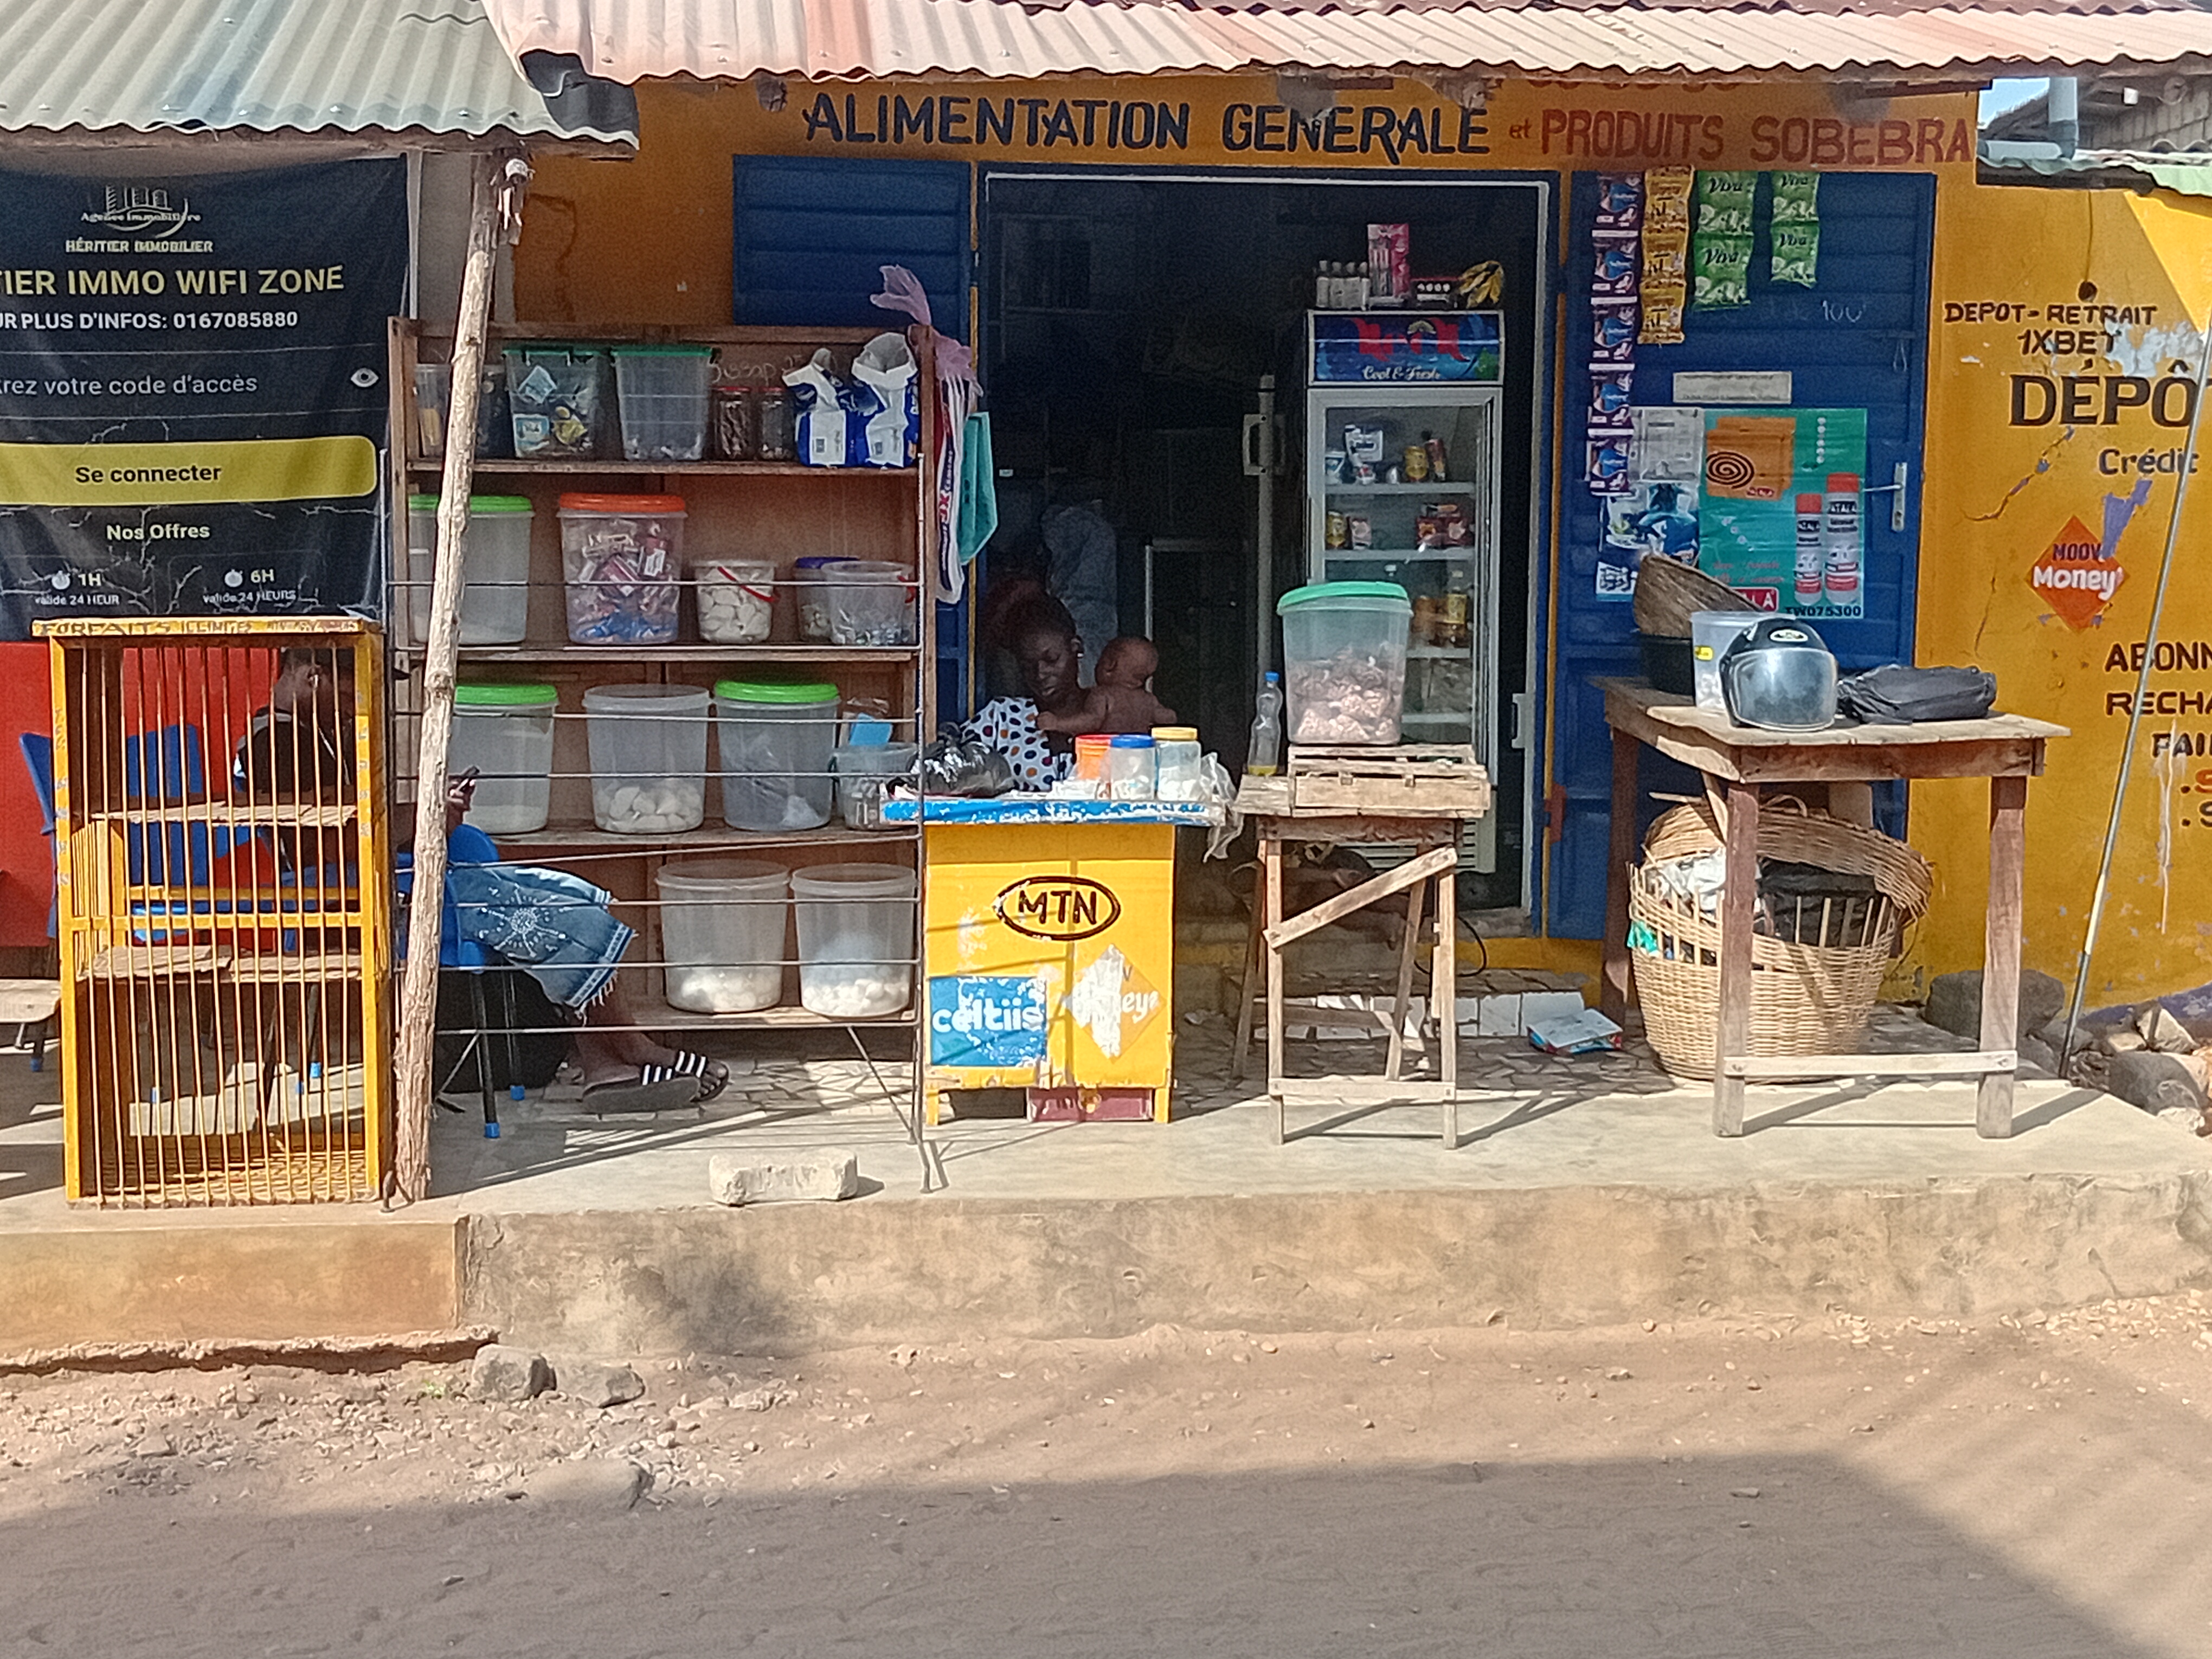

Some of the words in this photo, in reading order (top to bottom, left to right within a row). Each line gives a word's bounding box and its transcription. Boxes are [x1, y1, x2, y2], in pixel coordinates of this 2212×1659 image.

[802, 93, 1189, 150] ALIMENTATION
[1222, 104, 1490, 165] GENERALE
[1509, 118, 1531, 139] et
[1541, 109, 1724, 161] PRODUITS
[1750, 116, 1972, 165] SOBEBRA
[0, 269, 56, 294] IER
[68, 269, 165, 295] IMMO
[176, 270, 247, 294] WIFI
[259, 265, 344, 293] ZONE
[21, 312, 74, 329] PLUS
[80, 312, 168, 329] D'INFOS:
[173, 311, 298, 329] 0167085880
[2046, 305, 2157, 325] RETRAIT
[2017, 329, 2122, 355] 1XBET
[0, 380, 37, 395] rez
[44, 378, 102, 395] votre
[109, 375, 166, 395] code
[173, 375, 258, 394] d'accès
[2008, 358, 2212, 427] DÉPÔ
[75, 466, 104, 484] Se
[110, 465, 222, 483] connecter
[107, 524, 144, 541] Nos
[150, 524, 210, 540] Offres
[78, 573, 101, 587] 1H
[250, 569, 275, 583] 6H
[2033, 565, 2116, 601] Money
[69, 594, 84, 606] 24
[1017, 890, 1098, 924] MTN
